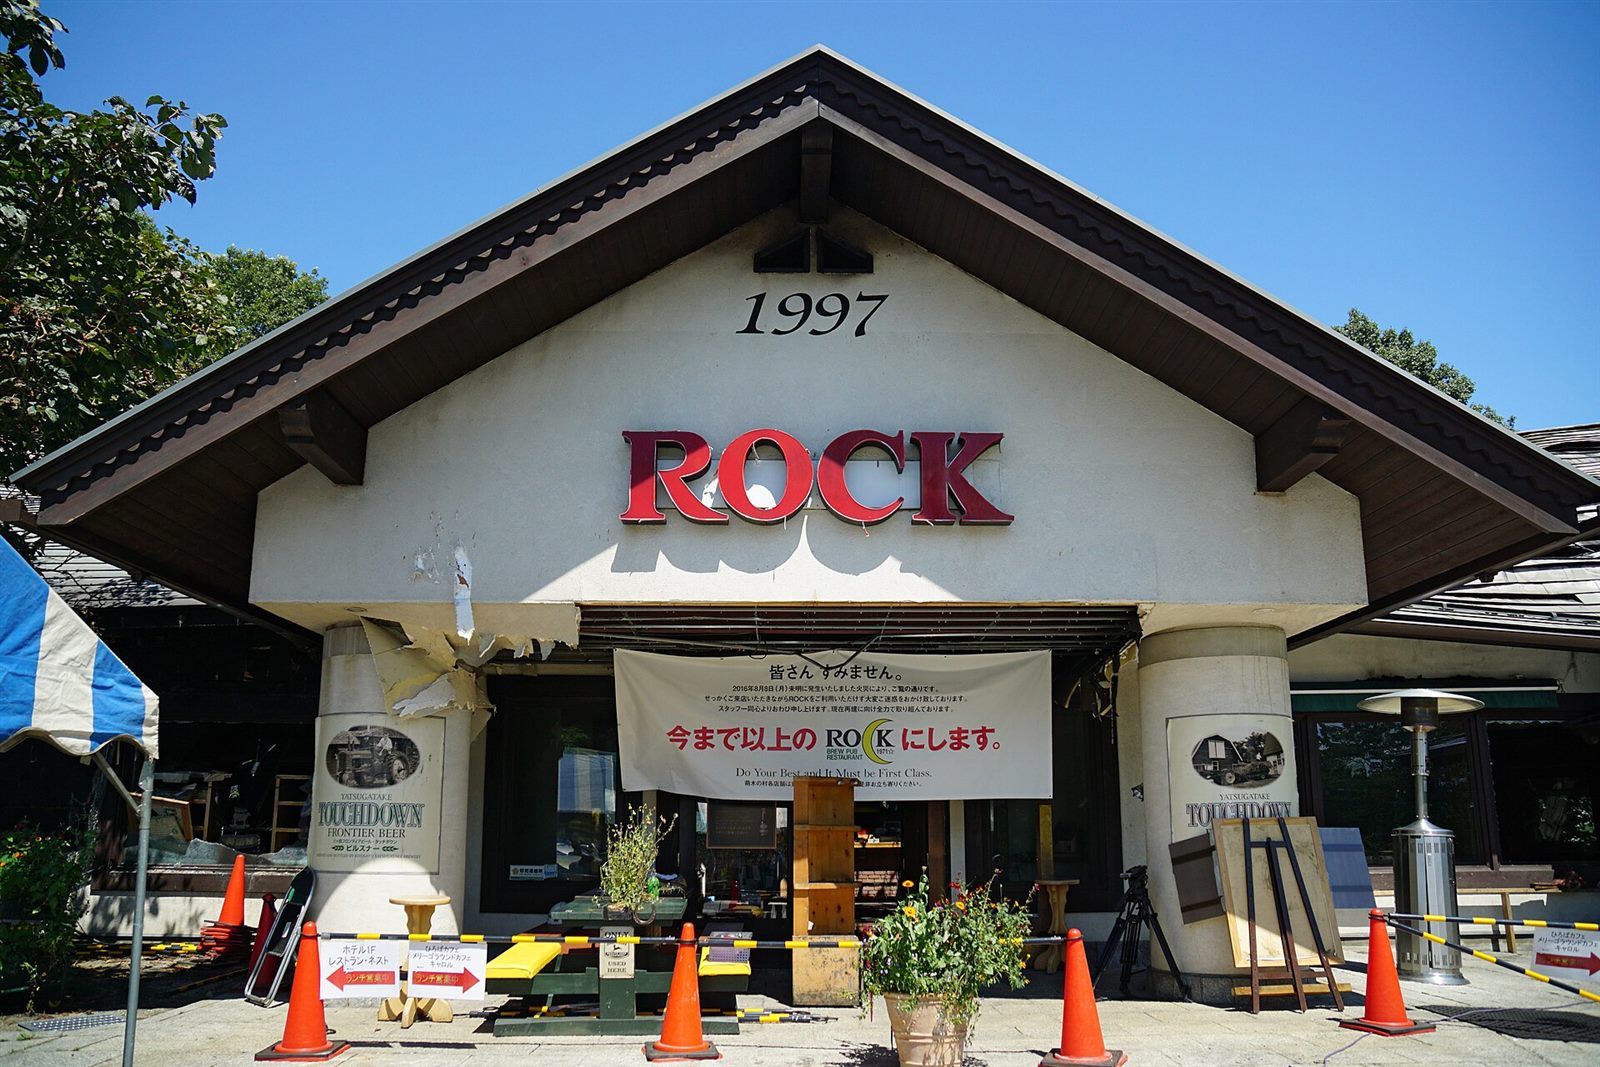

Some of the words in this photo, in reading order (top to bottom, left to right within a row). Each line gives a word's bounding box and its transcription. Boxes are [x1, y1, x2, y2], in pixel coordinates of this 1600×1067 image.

[736, 291, 889, 337] 1997
[619, 428, 1015, 525] ROCK
[769, 664, 814, 681] 皆さん
[822, 664, 902, 681] すみません。
[666, 725, 817, 751] 今まで以上の
[901, 726, 1000, 751] にします。
[736, 767, 751, 777] Do
[754, 768, 777, 777] Your
[780, 768, 801, 777] Best
[804, 768, 822, 777] and
[824, 768, 833, 777] It
[836, 768, 860, 778] Must
[864, 768, 876, 777] be
[878, 768, 902, 778] First
[904, 768, 932, 777] Class.
[341, 793, 392, 801] YATSUGATAKE
[1219, 793, 1271, 801] YATSUGATAKE
[318, 801, 425, 828] TOUCHDOWN
[327, 827, 375, 838] FRONTIER
[379, 828, 406, 838] BEER
[342, 945, 377, 954] ホテル1F
